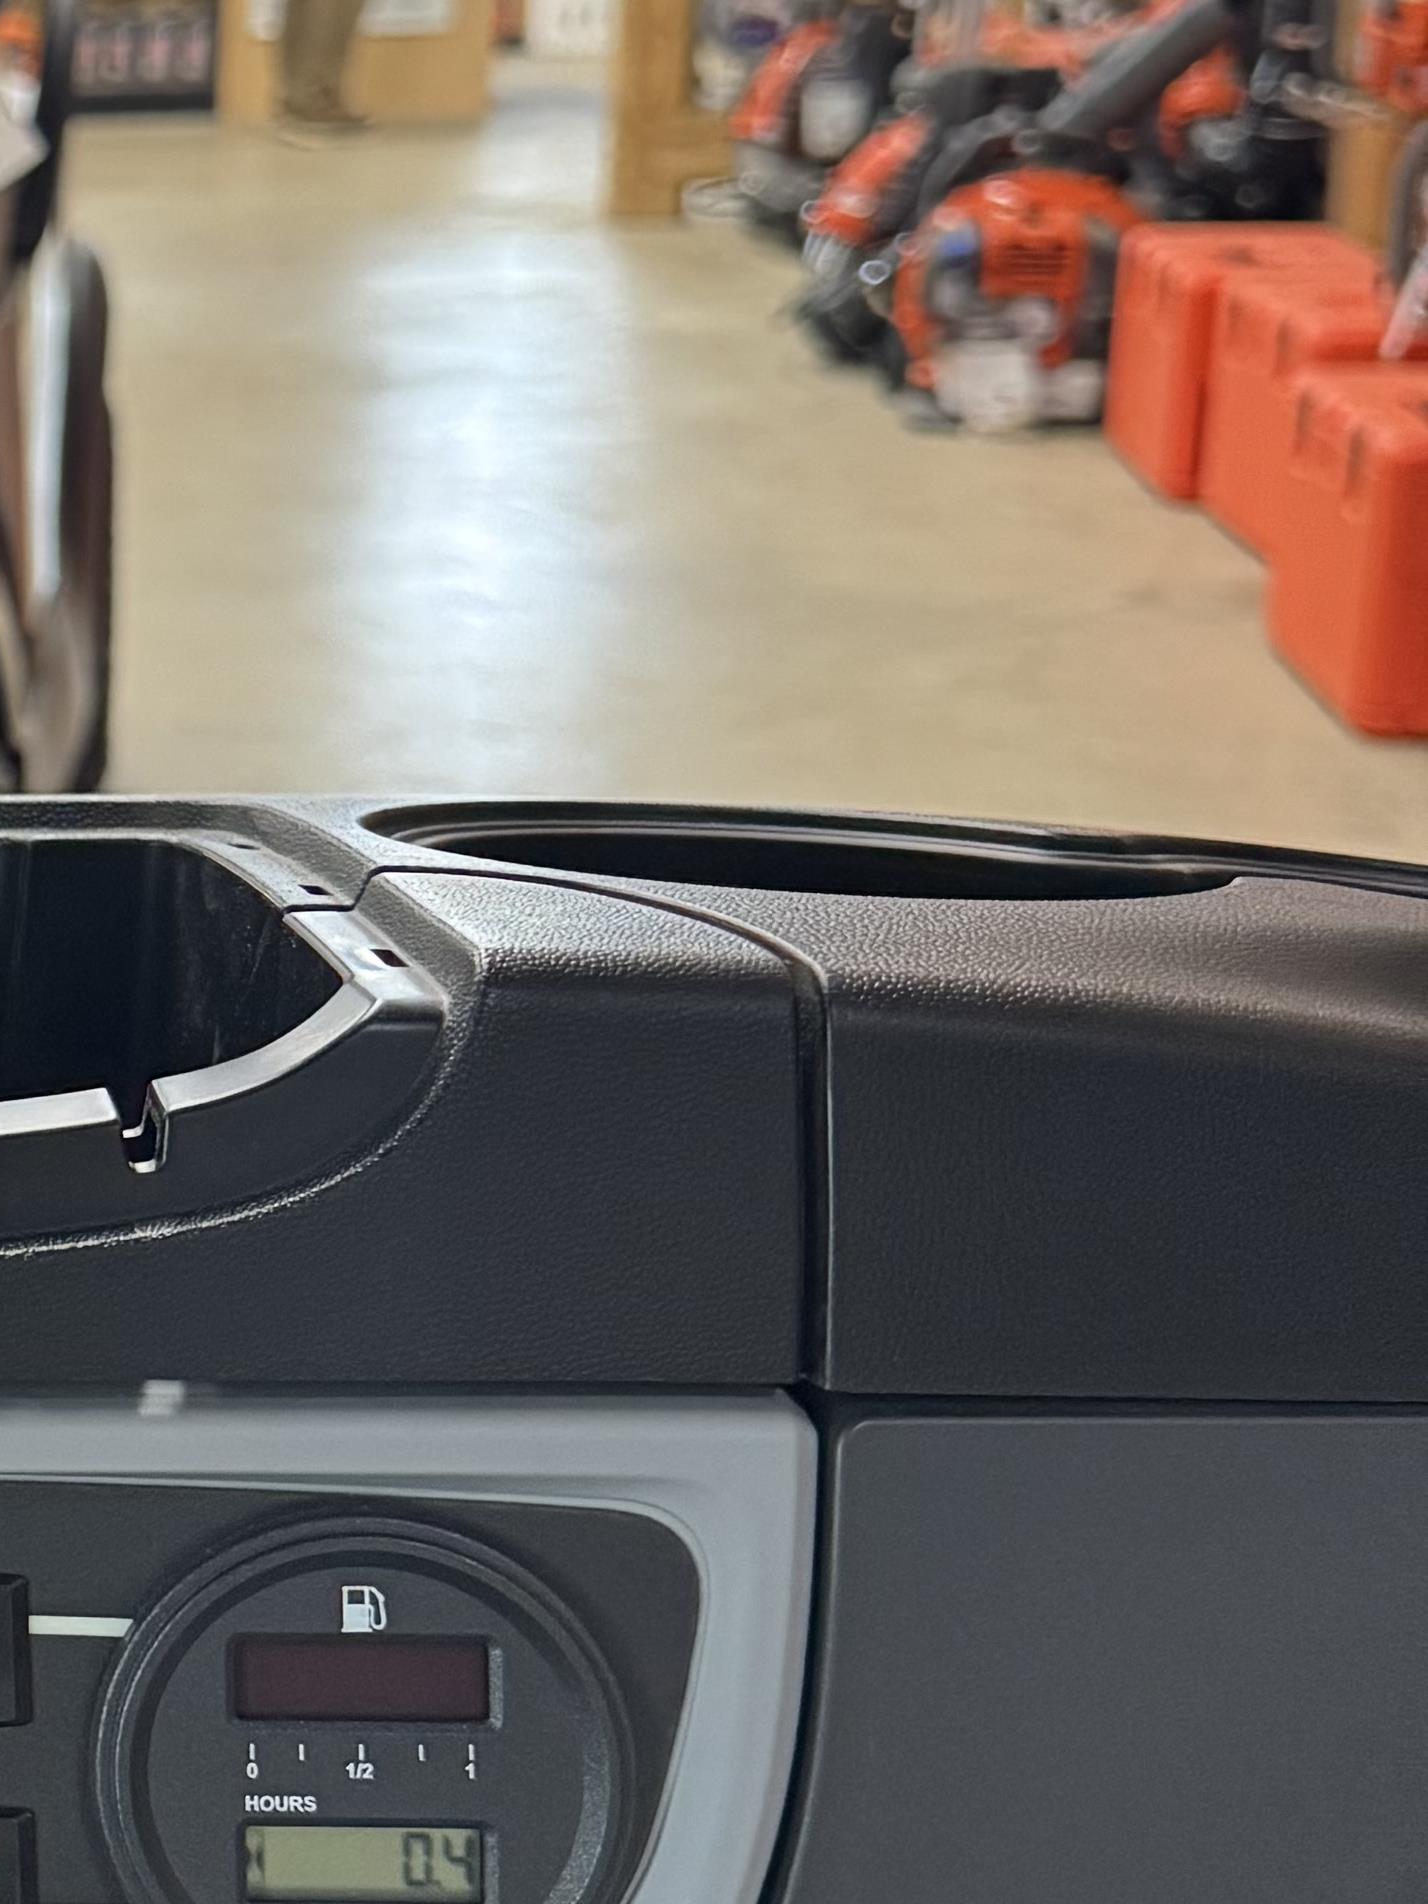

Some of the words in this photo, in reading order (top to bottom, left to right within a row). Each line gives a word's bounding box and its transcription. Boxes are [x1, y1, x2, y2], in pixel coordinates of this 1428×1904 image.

[245, 1762, 259, 1780] 0
[345, 1762, 375, 1780] 1/2
[464, 1762, 477, 1780] 1
[244, 1795, 317, 1813] HOURS
